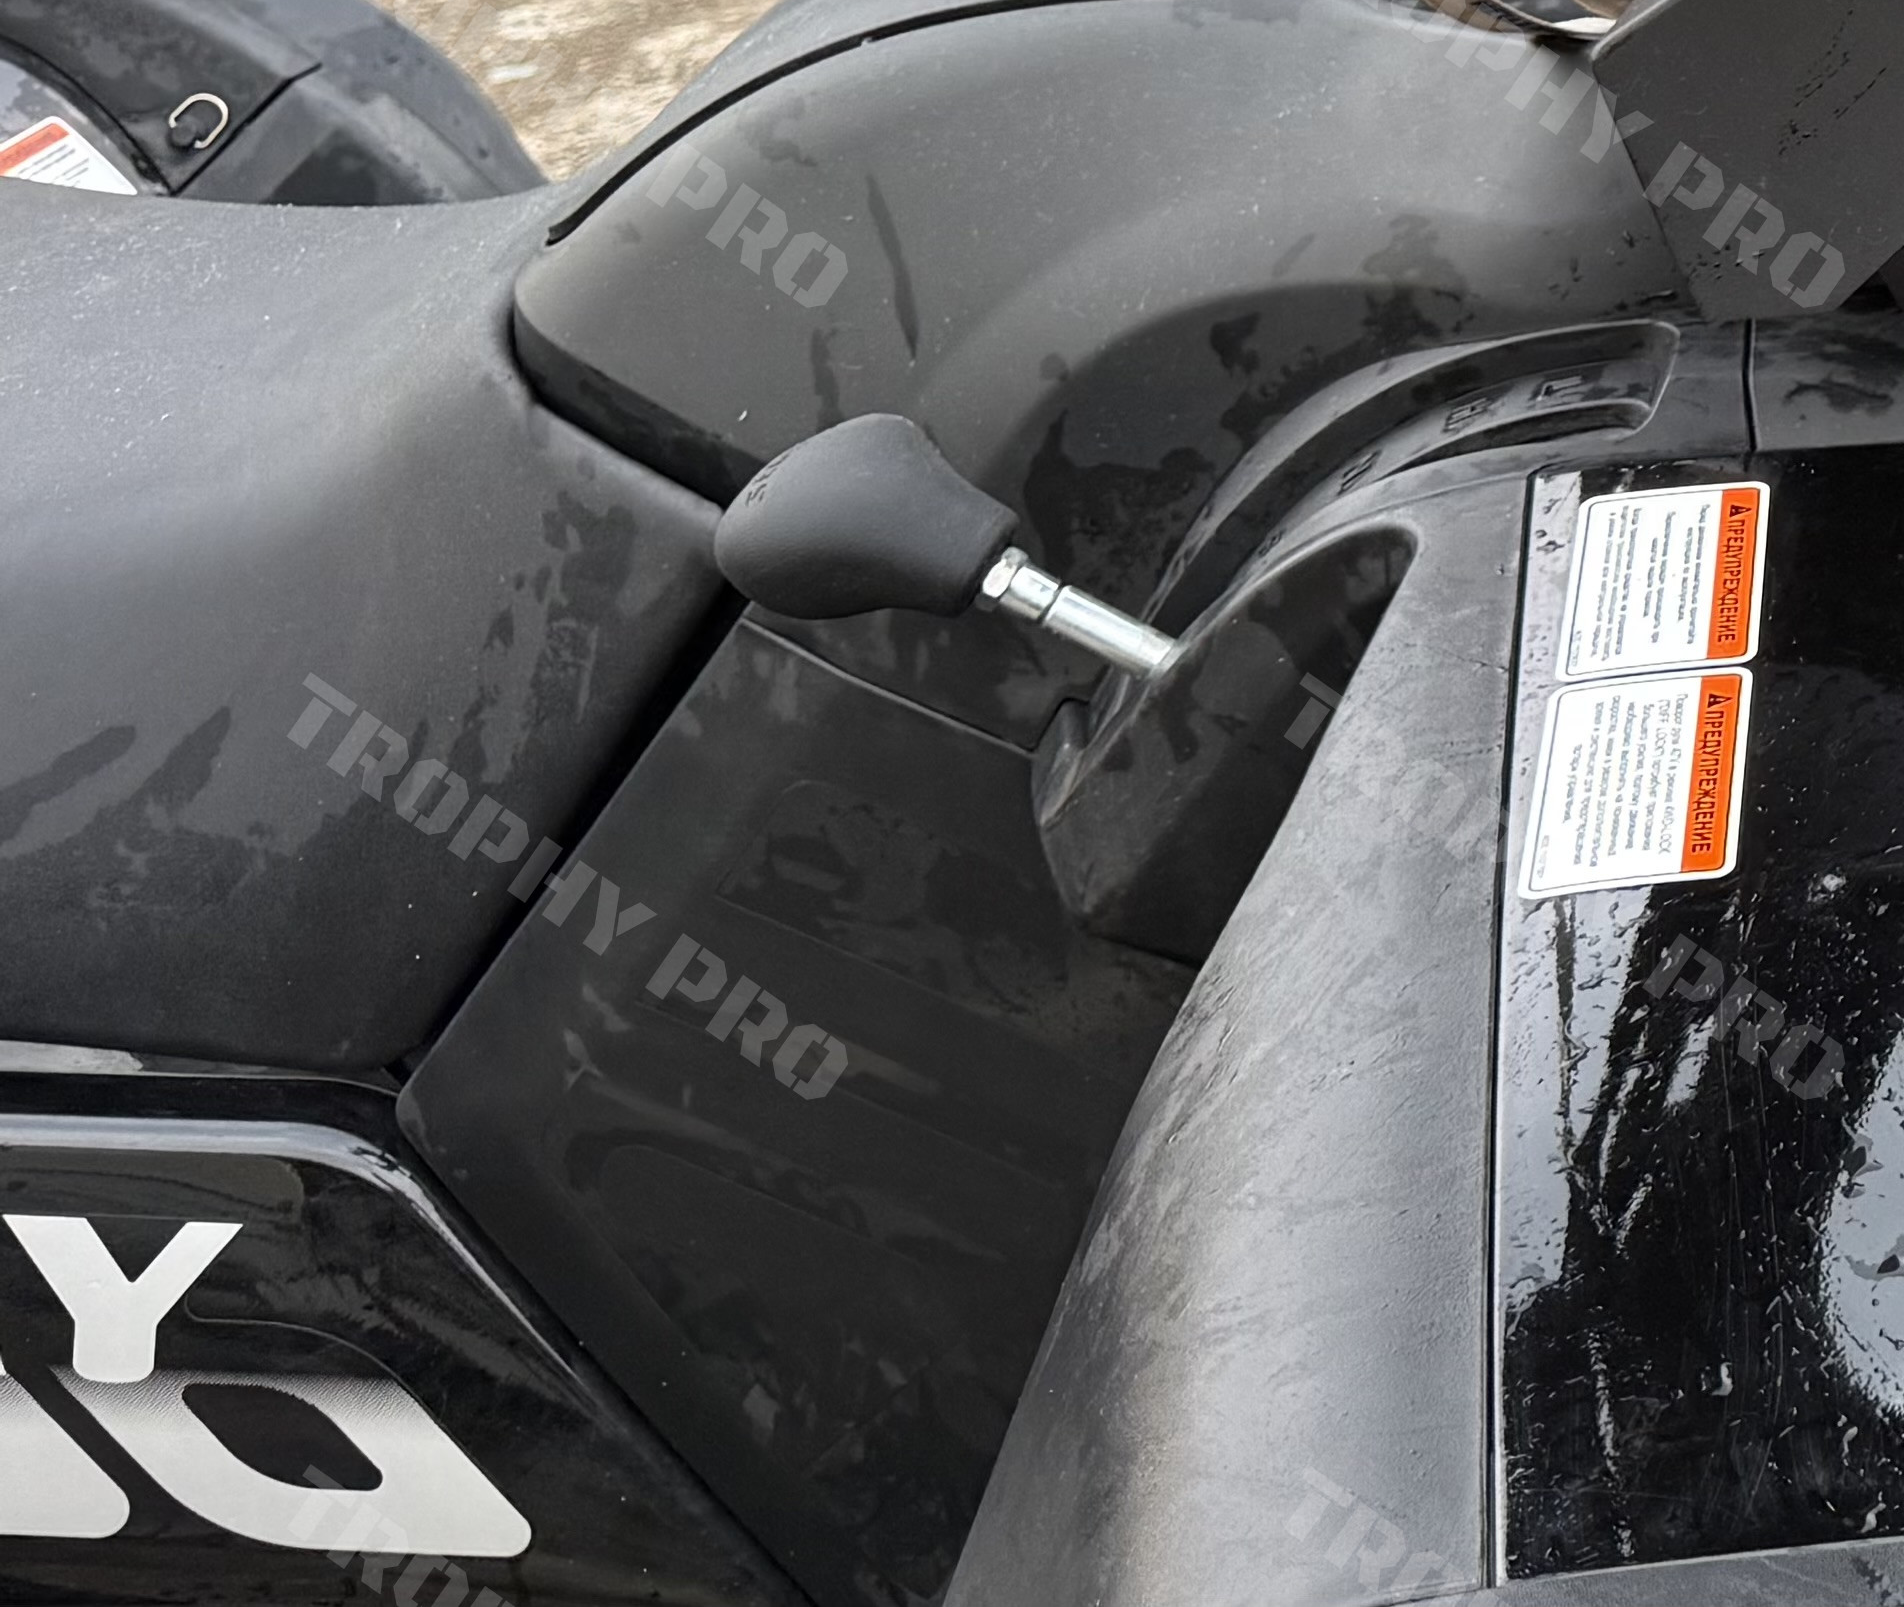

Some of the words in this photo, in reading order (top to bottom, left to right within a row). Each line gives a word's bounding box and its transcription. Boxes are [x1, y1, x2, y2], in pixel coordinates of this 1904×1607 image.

[1715, 518, 1745, 642] ПРЕДУПРЕЖДЕНИЕ
[1687, 709, 1725, 854] ПРЕДУПРЕЖДЕНИЕ
[0, 1214, 243, 1383] Y
